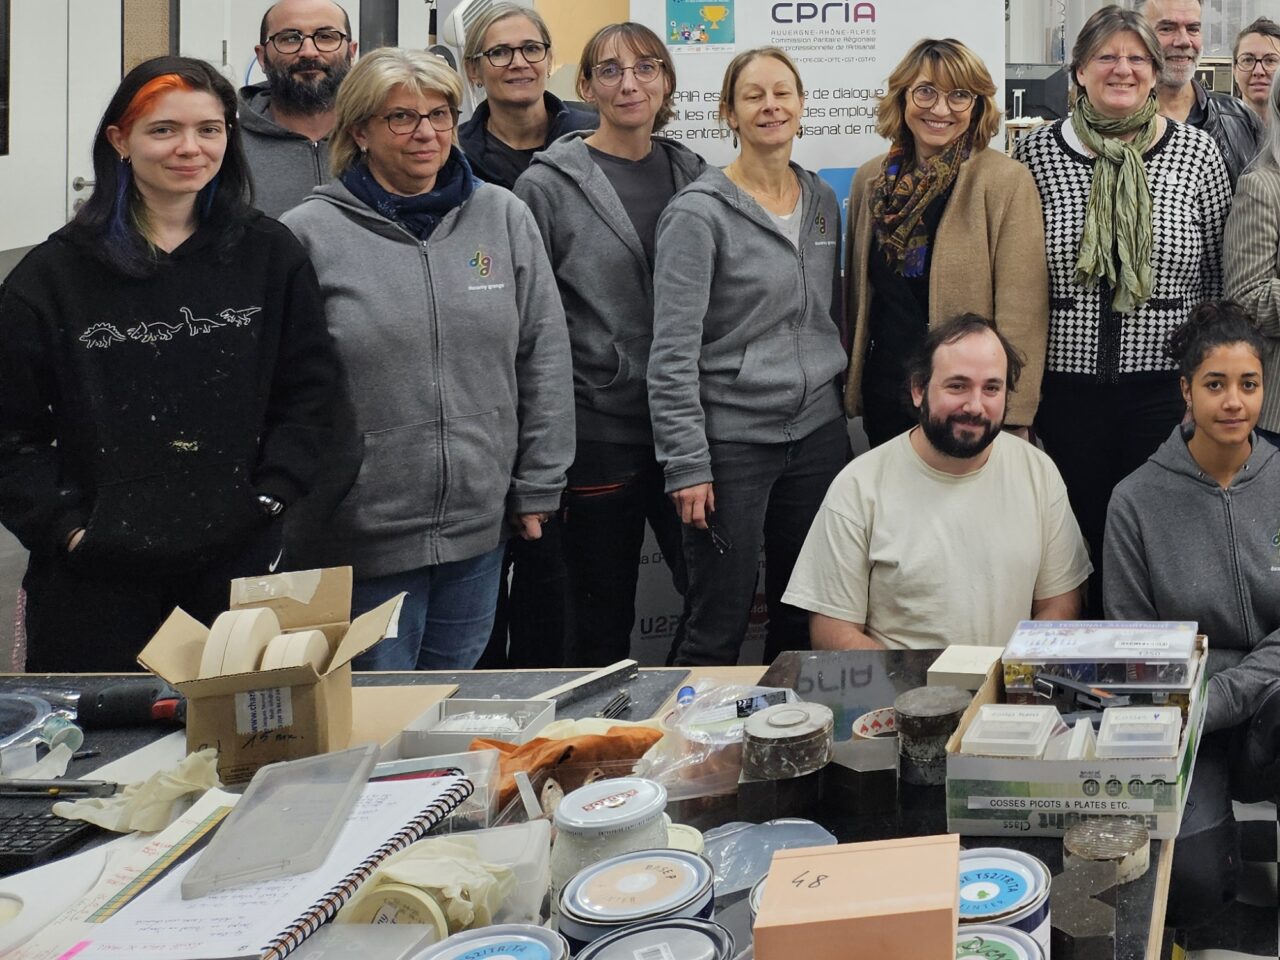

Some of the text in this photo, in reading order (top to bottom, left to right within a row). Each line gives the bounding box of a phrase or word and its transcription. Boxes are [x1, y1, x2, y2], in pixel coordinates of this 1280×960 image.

[704, 92, 721, 102] es
[813, 88, 829, 99] de
[833, 88, 884, 100] dialogue
[685, 110, 704, 121] les
[687, 128, 731, 141] entrepr
[845, 124, 861, 135] de
[990, 799, 1130, 810] COSSES PICOTS & PLATES ETC.
[1003, 821, 1031, 831] Class
